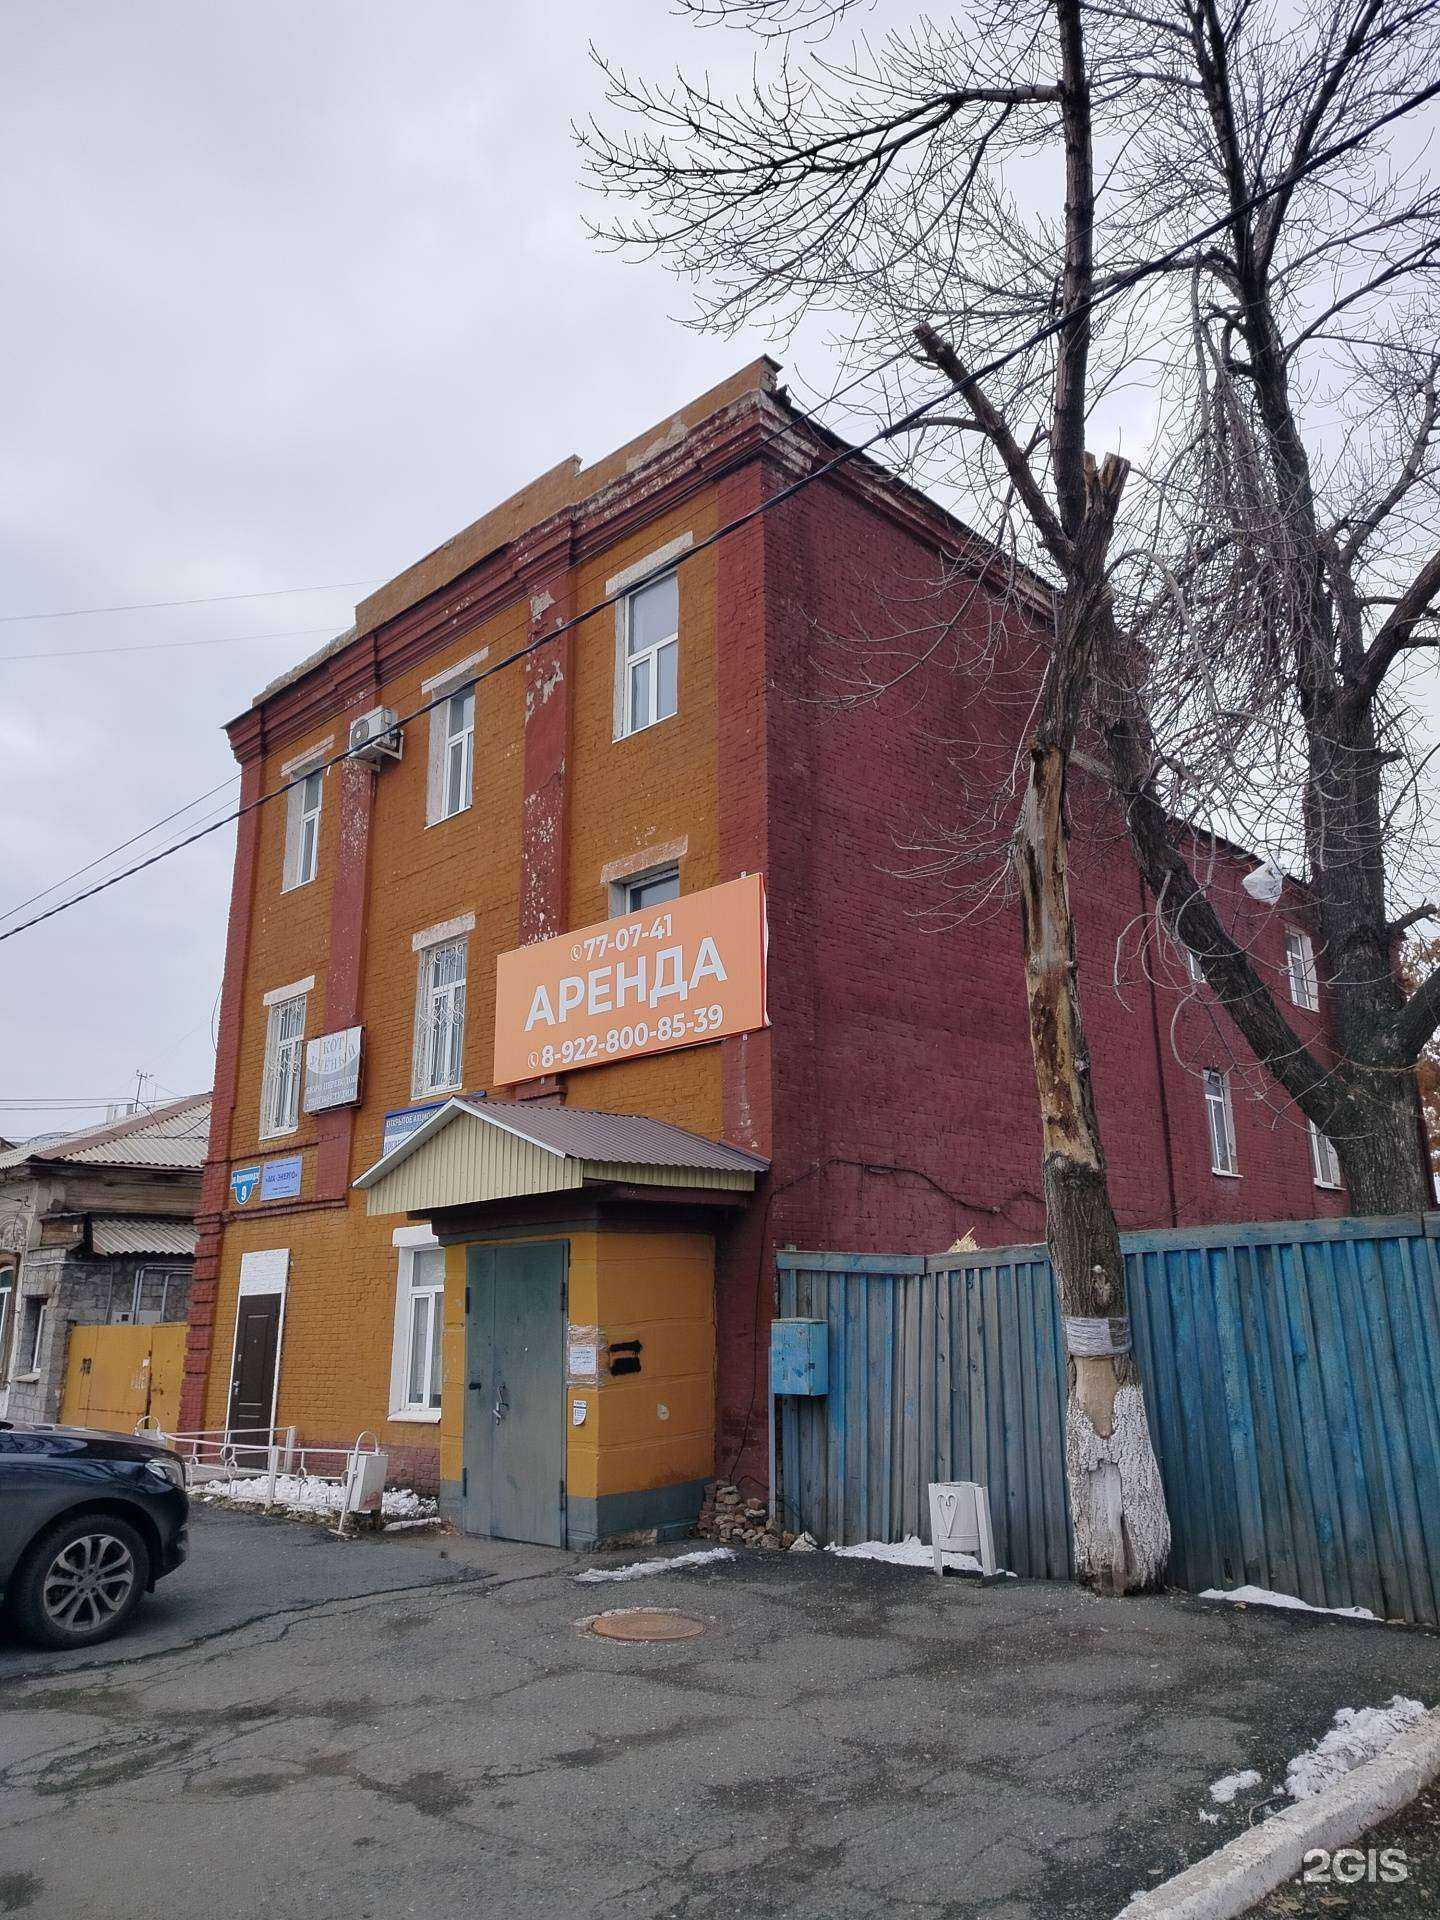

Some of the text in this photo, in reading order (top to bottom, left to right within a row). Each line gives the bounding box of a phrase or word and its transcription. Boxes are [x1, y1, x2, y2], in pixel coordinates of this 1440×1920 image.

[583, 914, 672, 961] 77-07-41
[524, 936, 728, 1032] АРЕНДА
[323, 1037, 343, 1055] КОТ
[541, 1004, 723, 1068] 8-922-800-85-39
[241, 1185, 247, 1201] 9
